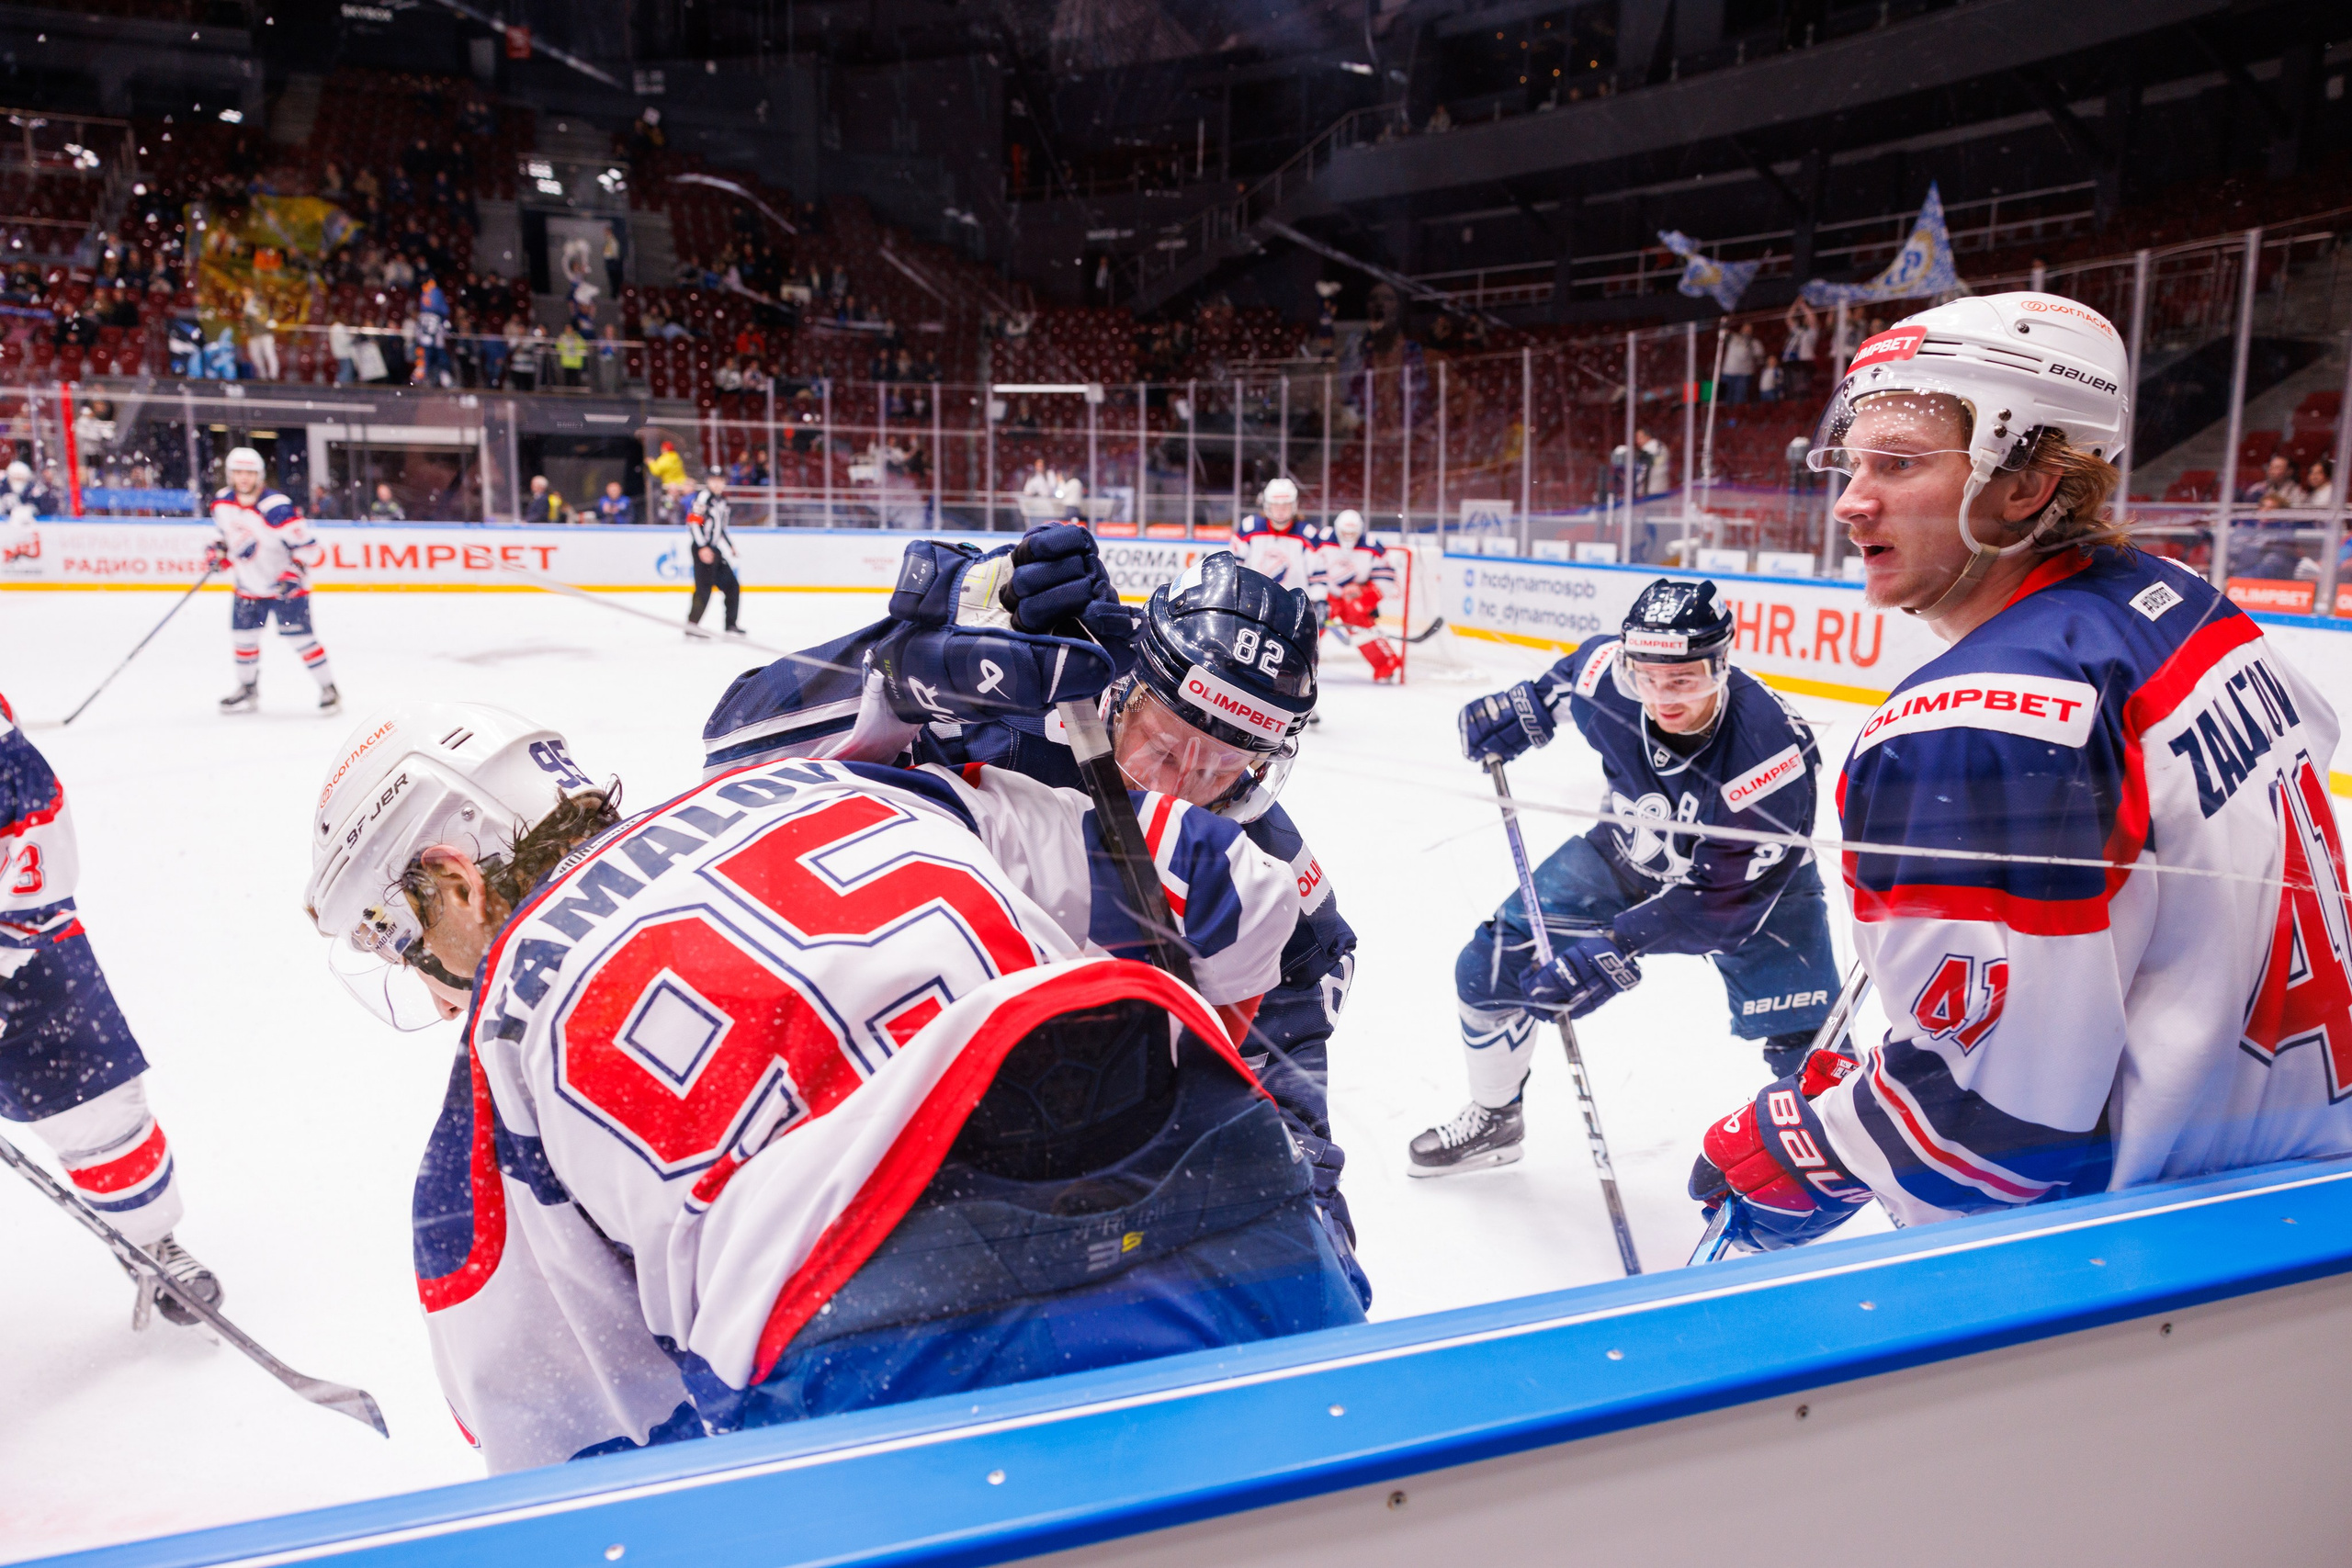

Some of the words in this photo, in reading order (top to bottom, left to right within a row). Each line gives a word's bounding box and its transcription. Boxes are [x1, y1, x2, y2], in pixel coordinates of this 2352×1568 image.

[2050, 304, 2113, 336] СОГЛАСИЕ
[2049, 363, 2117, 395] BAUER
[63, 558, 148, 575] РАДИО
[1481, 571, 1597, 600] hcdynamospb
[1644, 601, 1678, 625] 22
[2227, 587, 2312, 606] OLIMPBET
[1233, 627, 1284, 679] 82
[1628, 637, 1683, 649] OLIMPBET
[1725, 600, 1884, 668] HR.RU
[1188, 679, 1286, 733] OLIMPBET
[1863, 689, 2082, 739] OLIMPBET
[332, 720, 395, 784] СОГЛАСИЕ
[528, 739, 594, 789] 95
[1729, 753, 1802, 802] OLIMPBET
[482, 761, 839, 1045] YAMALOV
[375, 935, 390, 953] MAD
[385, 921, 399, 939] GUY
[552, 788, 1047, 1182] 95
[1742, 989, 1828, 1016] BAUER
[1910, 953, 2009, 1057] 41
